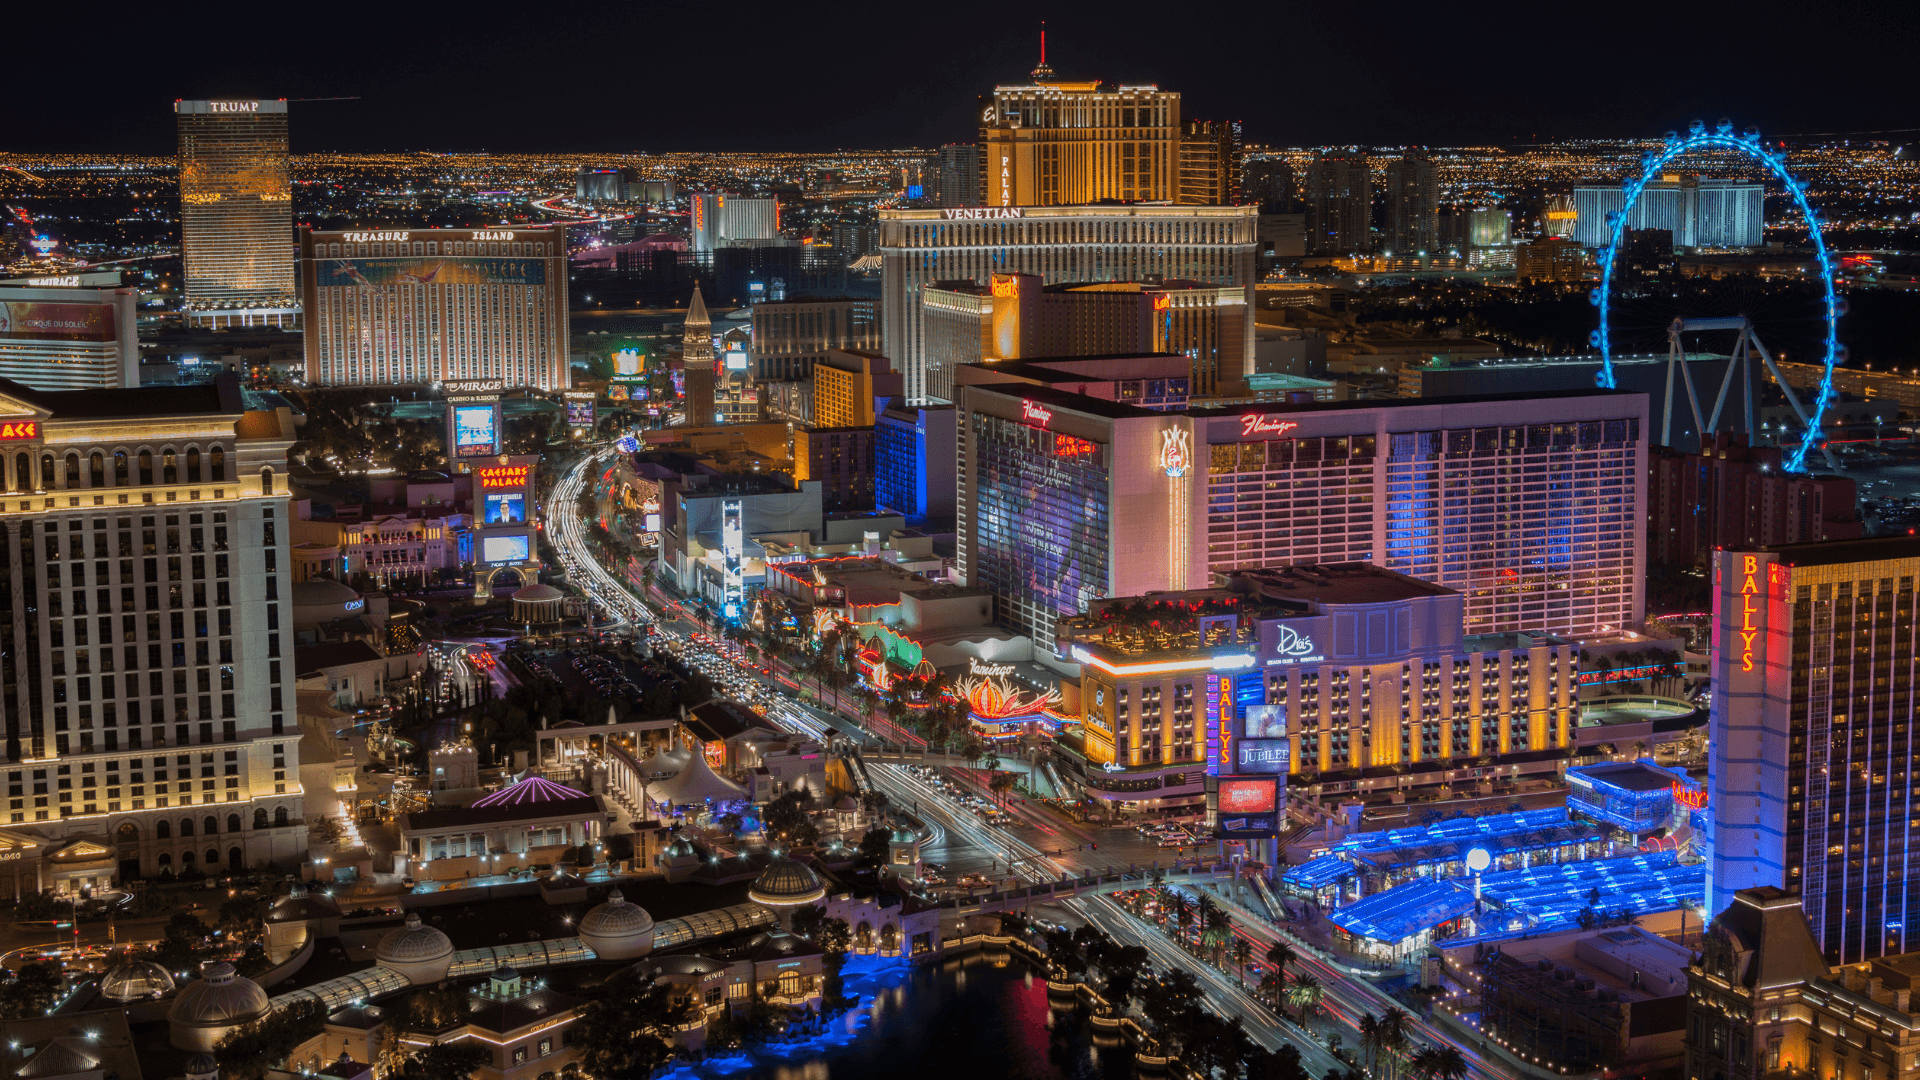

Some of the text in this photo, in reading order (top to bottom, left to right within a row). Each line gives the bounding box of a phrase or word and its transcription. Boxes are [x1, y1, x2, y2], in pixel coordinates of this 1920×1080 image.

[210, 102, 259, 113] TRUMP
[945, 208, 1021, 219] VENETIAN
[342, 231, 515, 243] TREASURE ISLAND
[40, 276, 79, 286] MIRAGE
[27, 319, 52, 329] CIRQUE
[53, 320, 63, 328] DU
[64, 320, 88, 329] SOLEIL
[454, 381, 502, 392] MIRAGE
[1241, 414, 1298, 436] Flamingo
[480, 467, 528, 478] CAESARS
[483, 477, 526, 488] PALACE
[1740, 555, 1760, 672] BALLYS
[1219, 678, 1232, 764] BALLYS
[1239, 748, 1290, 765] JUBILEE
